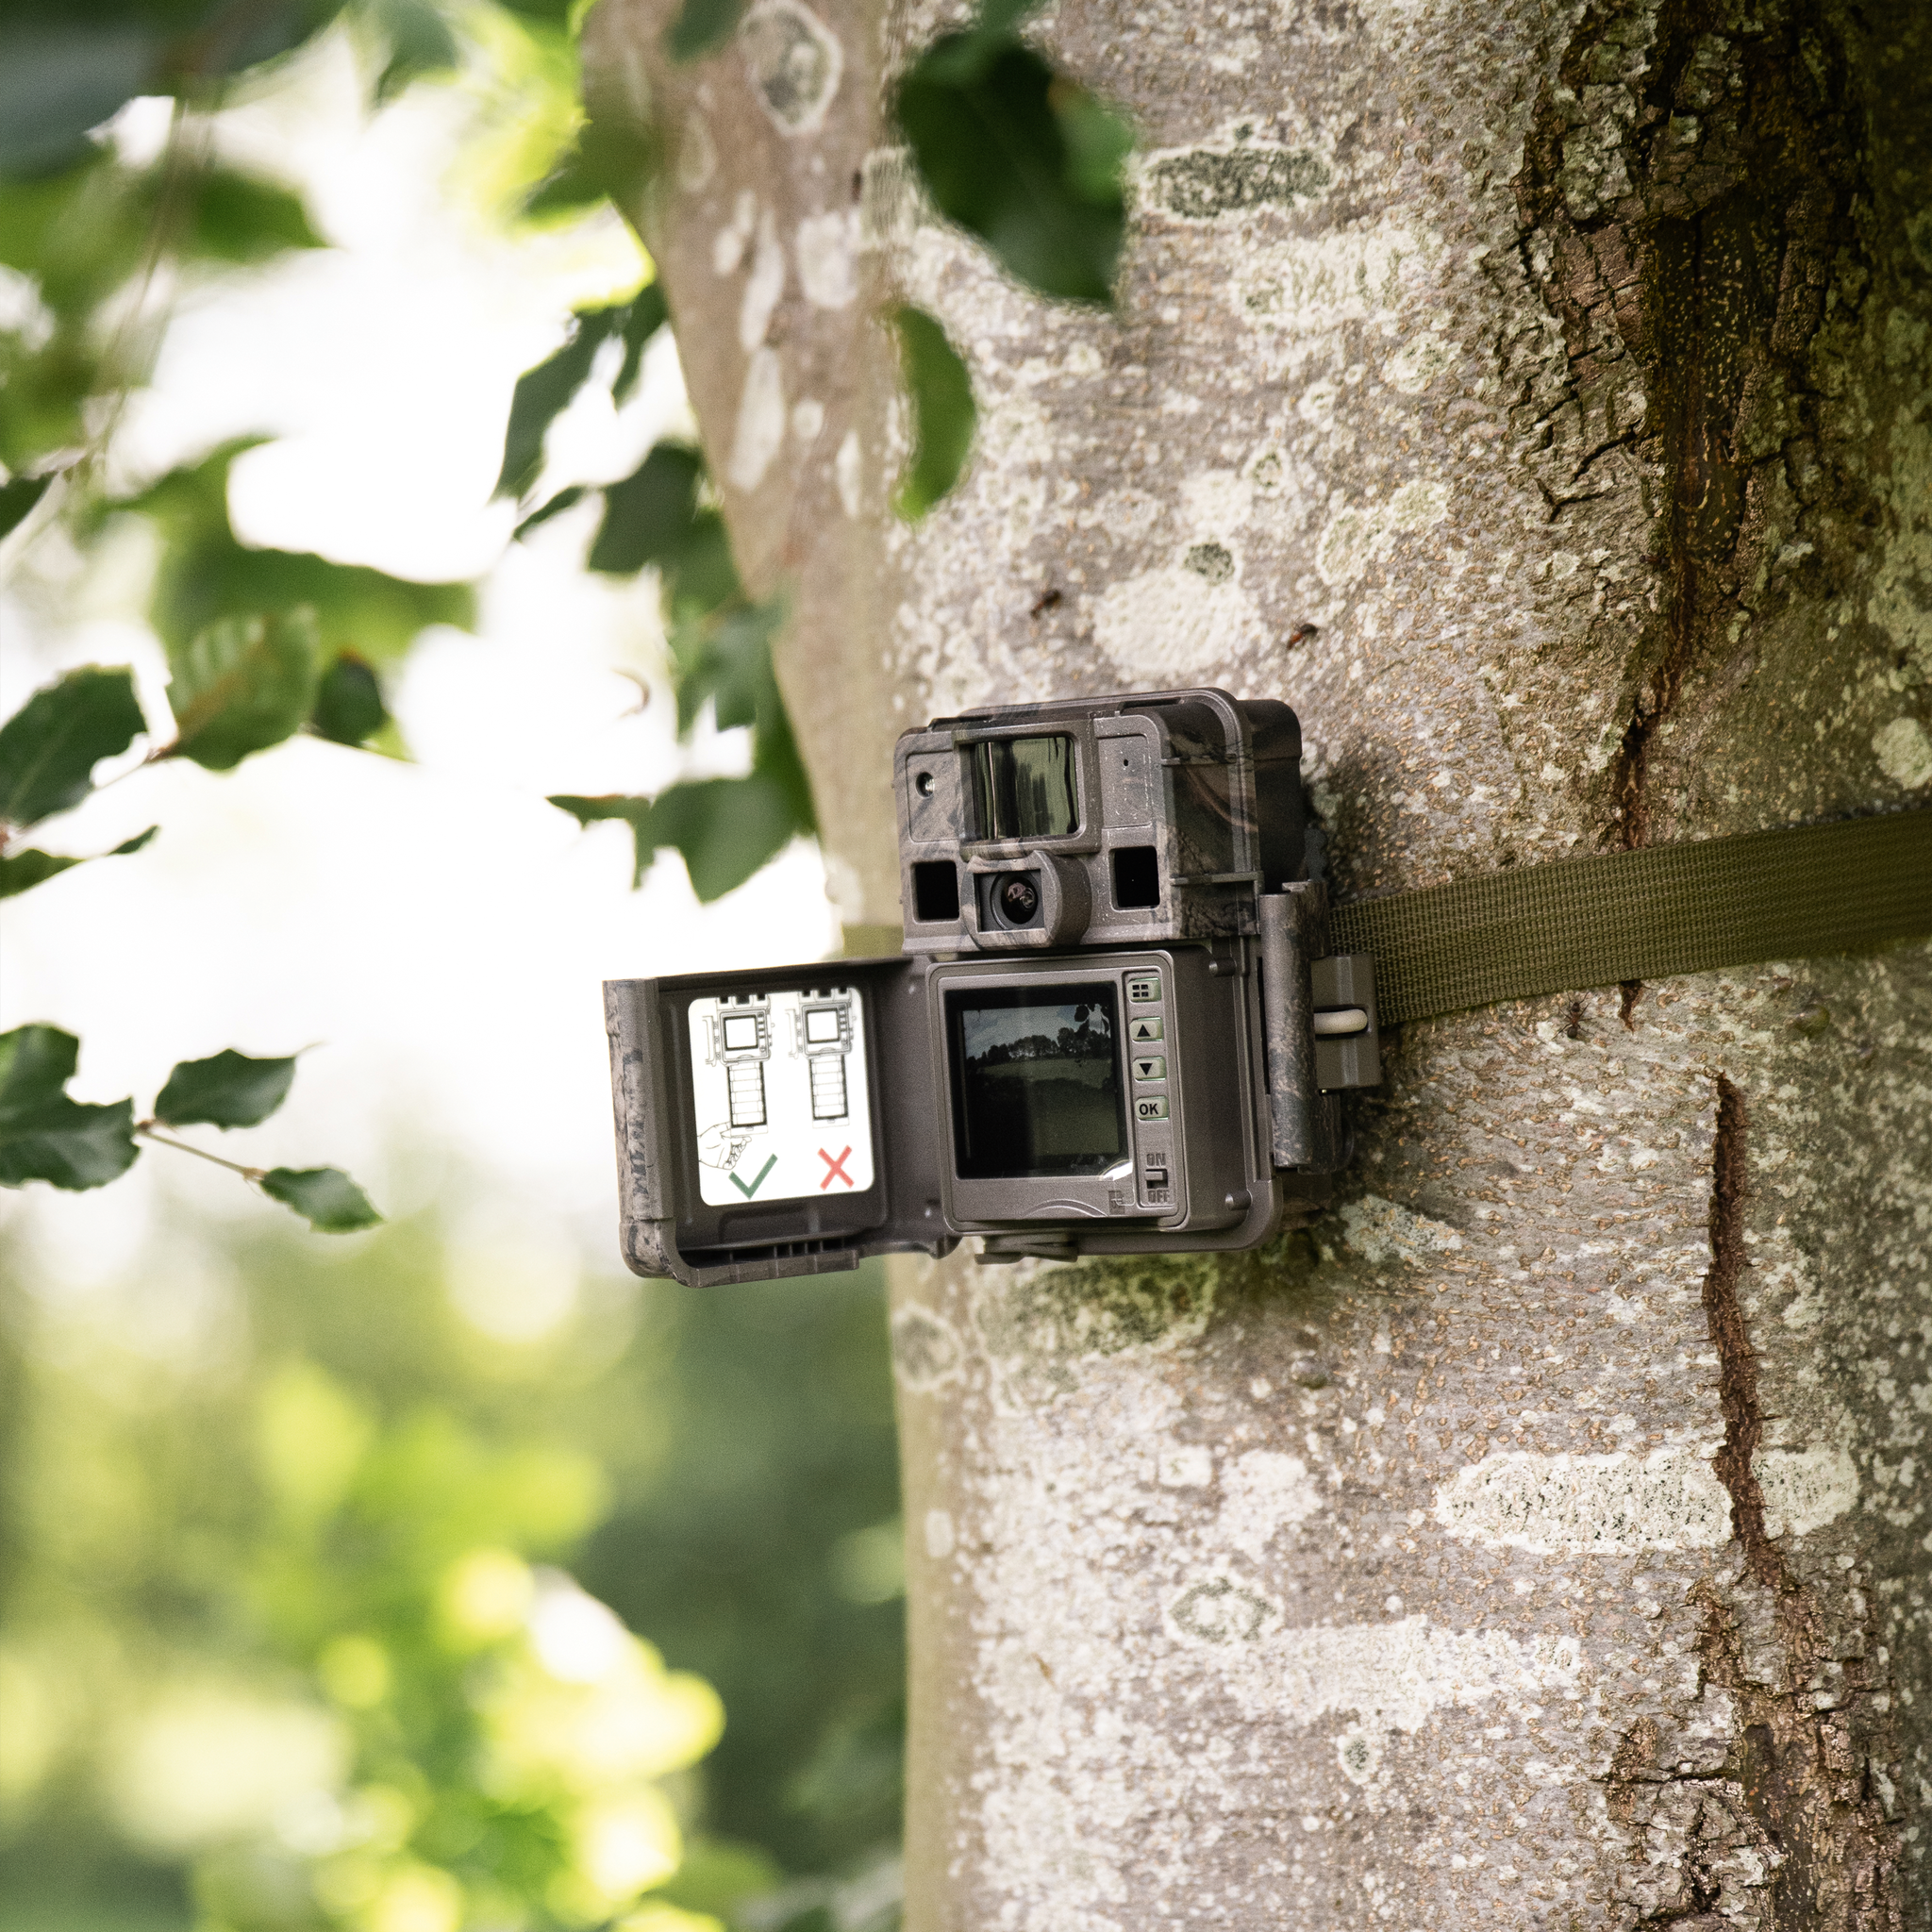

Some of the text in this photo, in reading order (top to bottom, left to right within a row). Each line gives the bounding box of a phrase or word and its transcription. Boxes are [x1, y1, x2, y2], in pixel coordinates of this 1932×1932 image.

[1139, 1103, 1158, 1115] OK
[1146, 1153, 1165, 1167] ON
[1147, 1190, 1169, 1204] OFF
